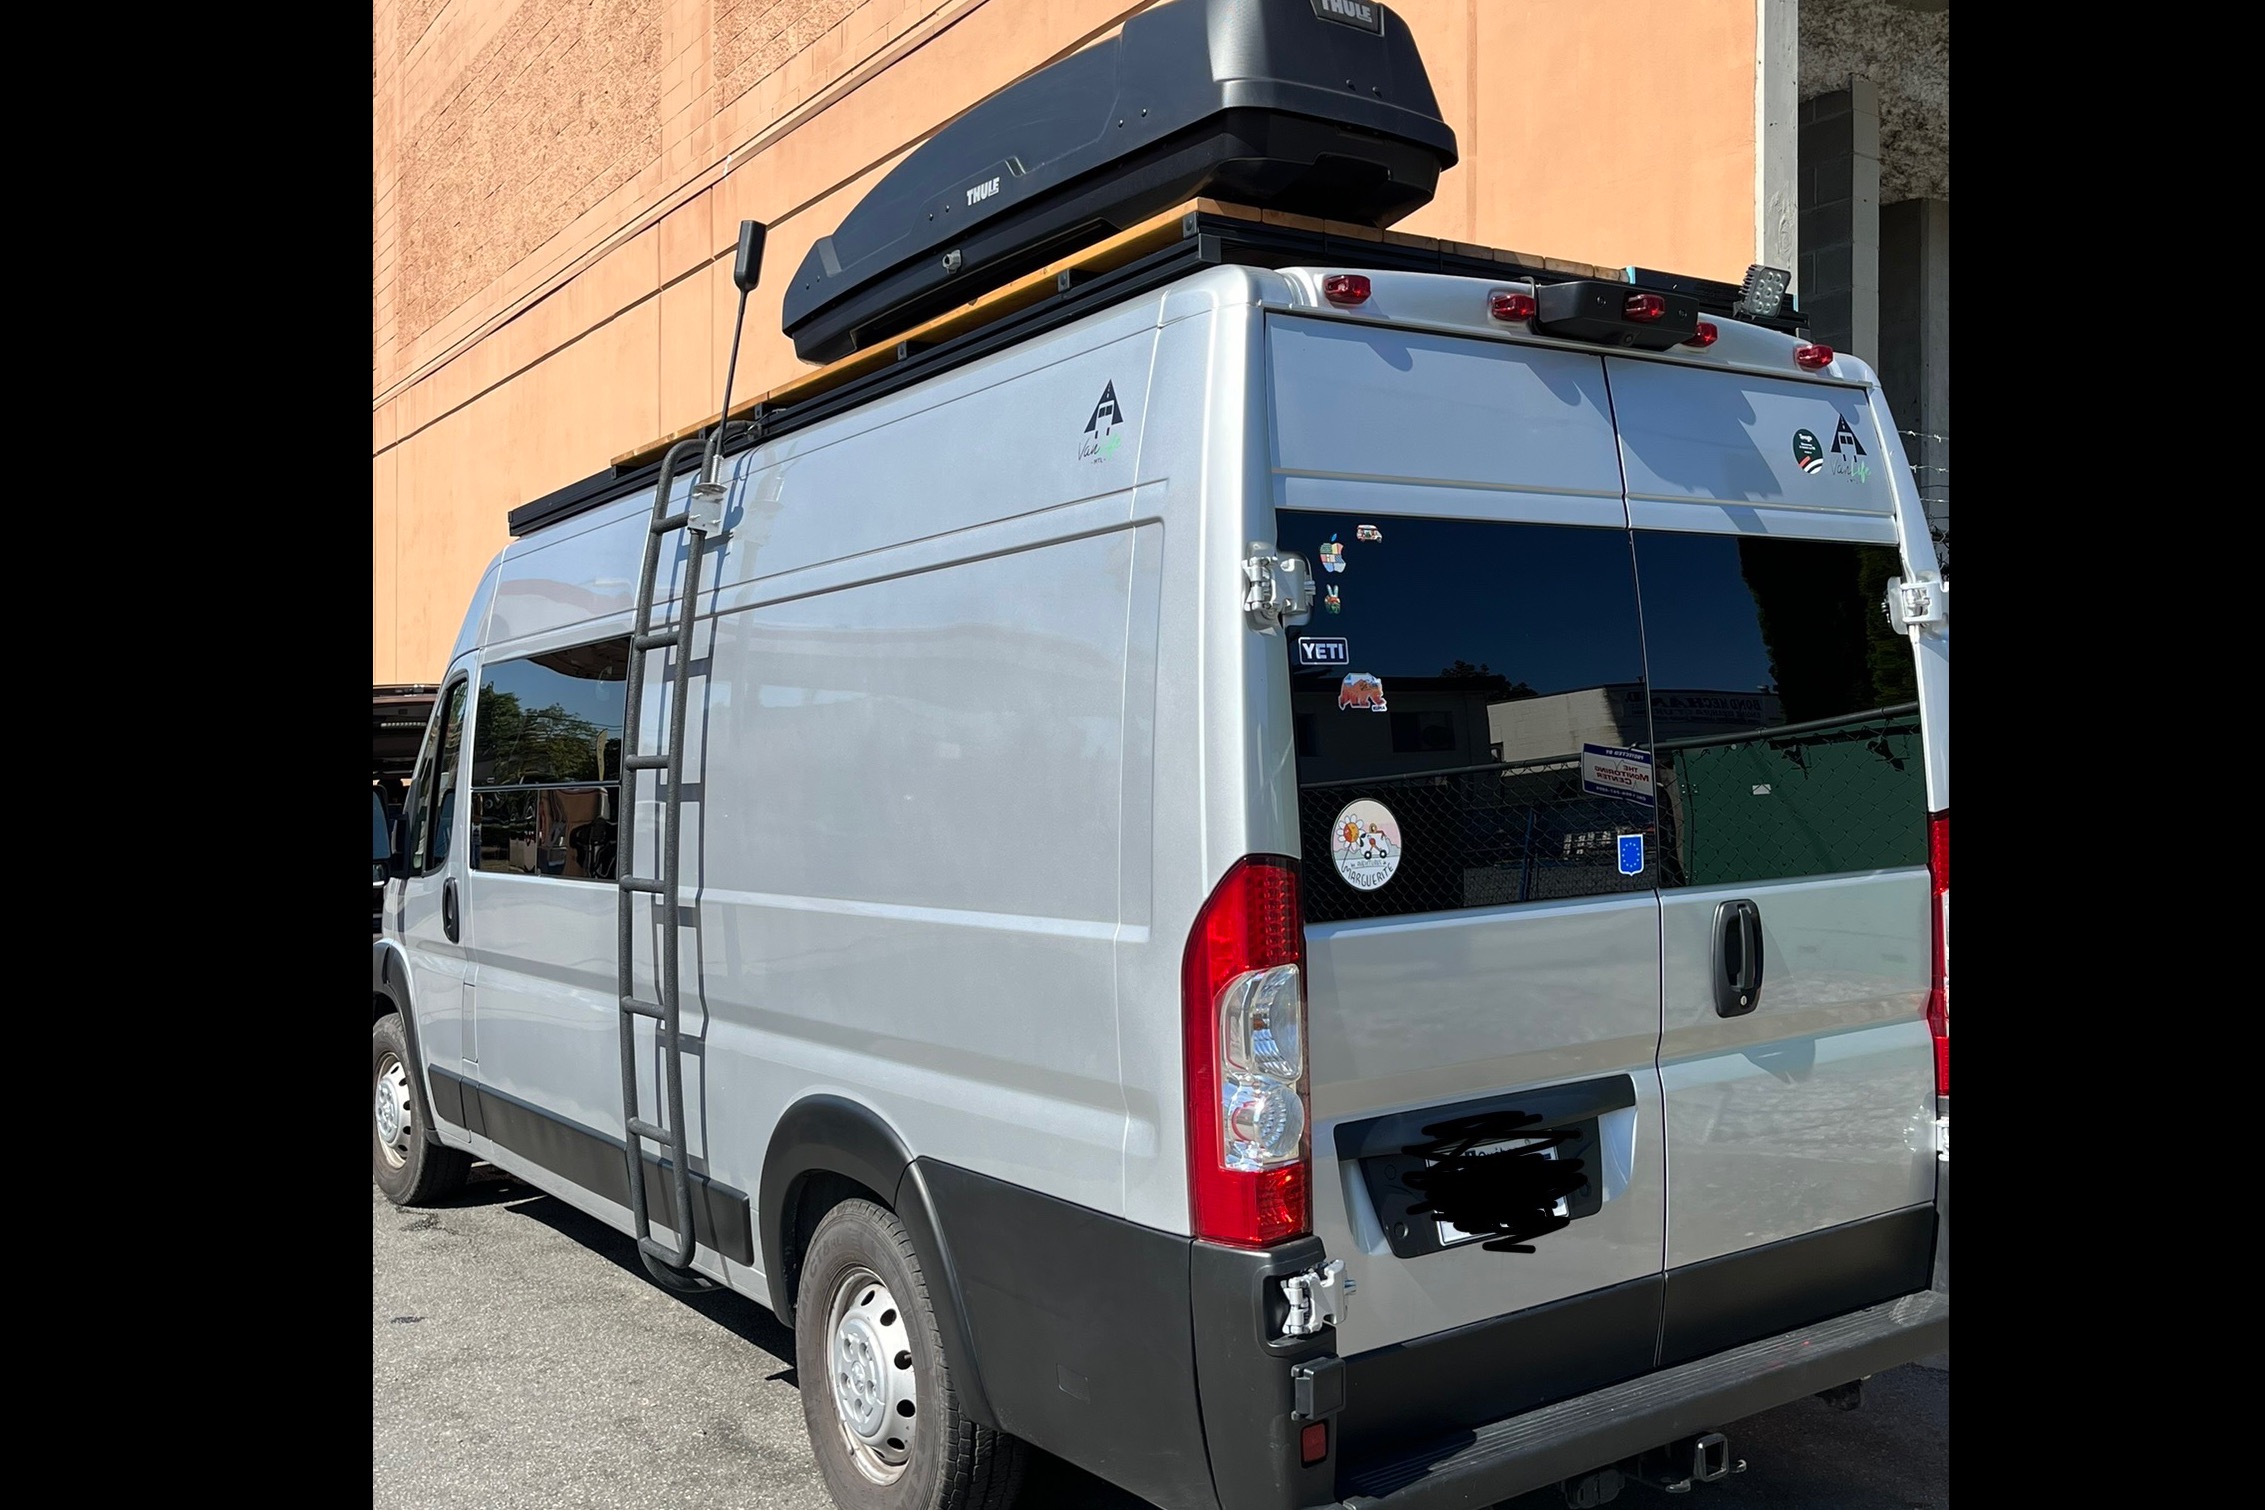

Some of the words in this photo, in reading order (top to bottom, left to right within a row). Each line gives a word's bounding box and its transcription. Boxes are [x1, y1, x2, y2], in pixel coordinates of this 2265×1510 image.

[1321, 0, 1373, 23] THULE
[966, 176, 1000, 206] THULE
[1302, 643, 1344, 659] YETI
[1341, 862, 1394, 887] MARGUERITE
